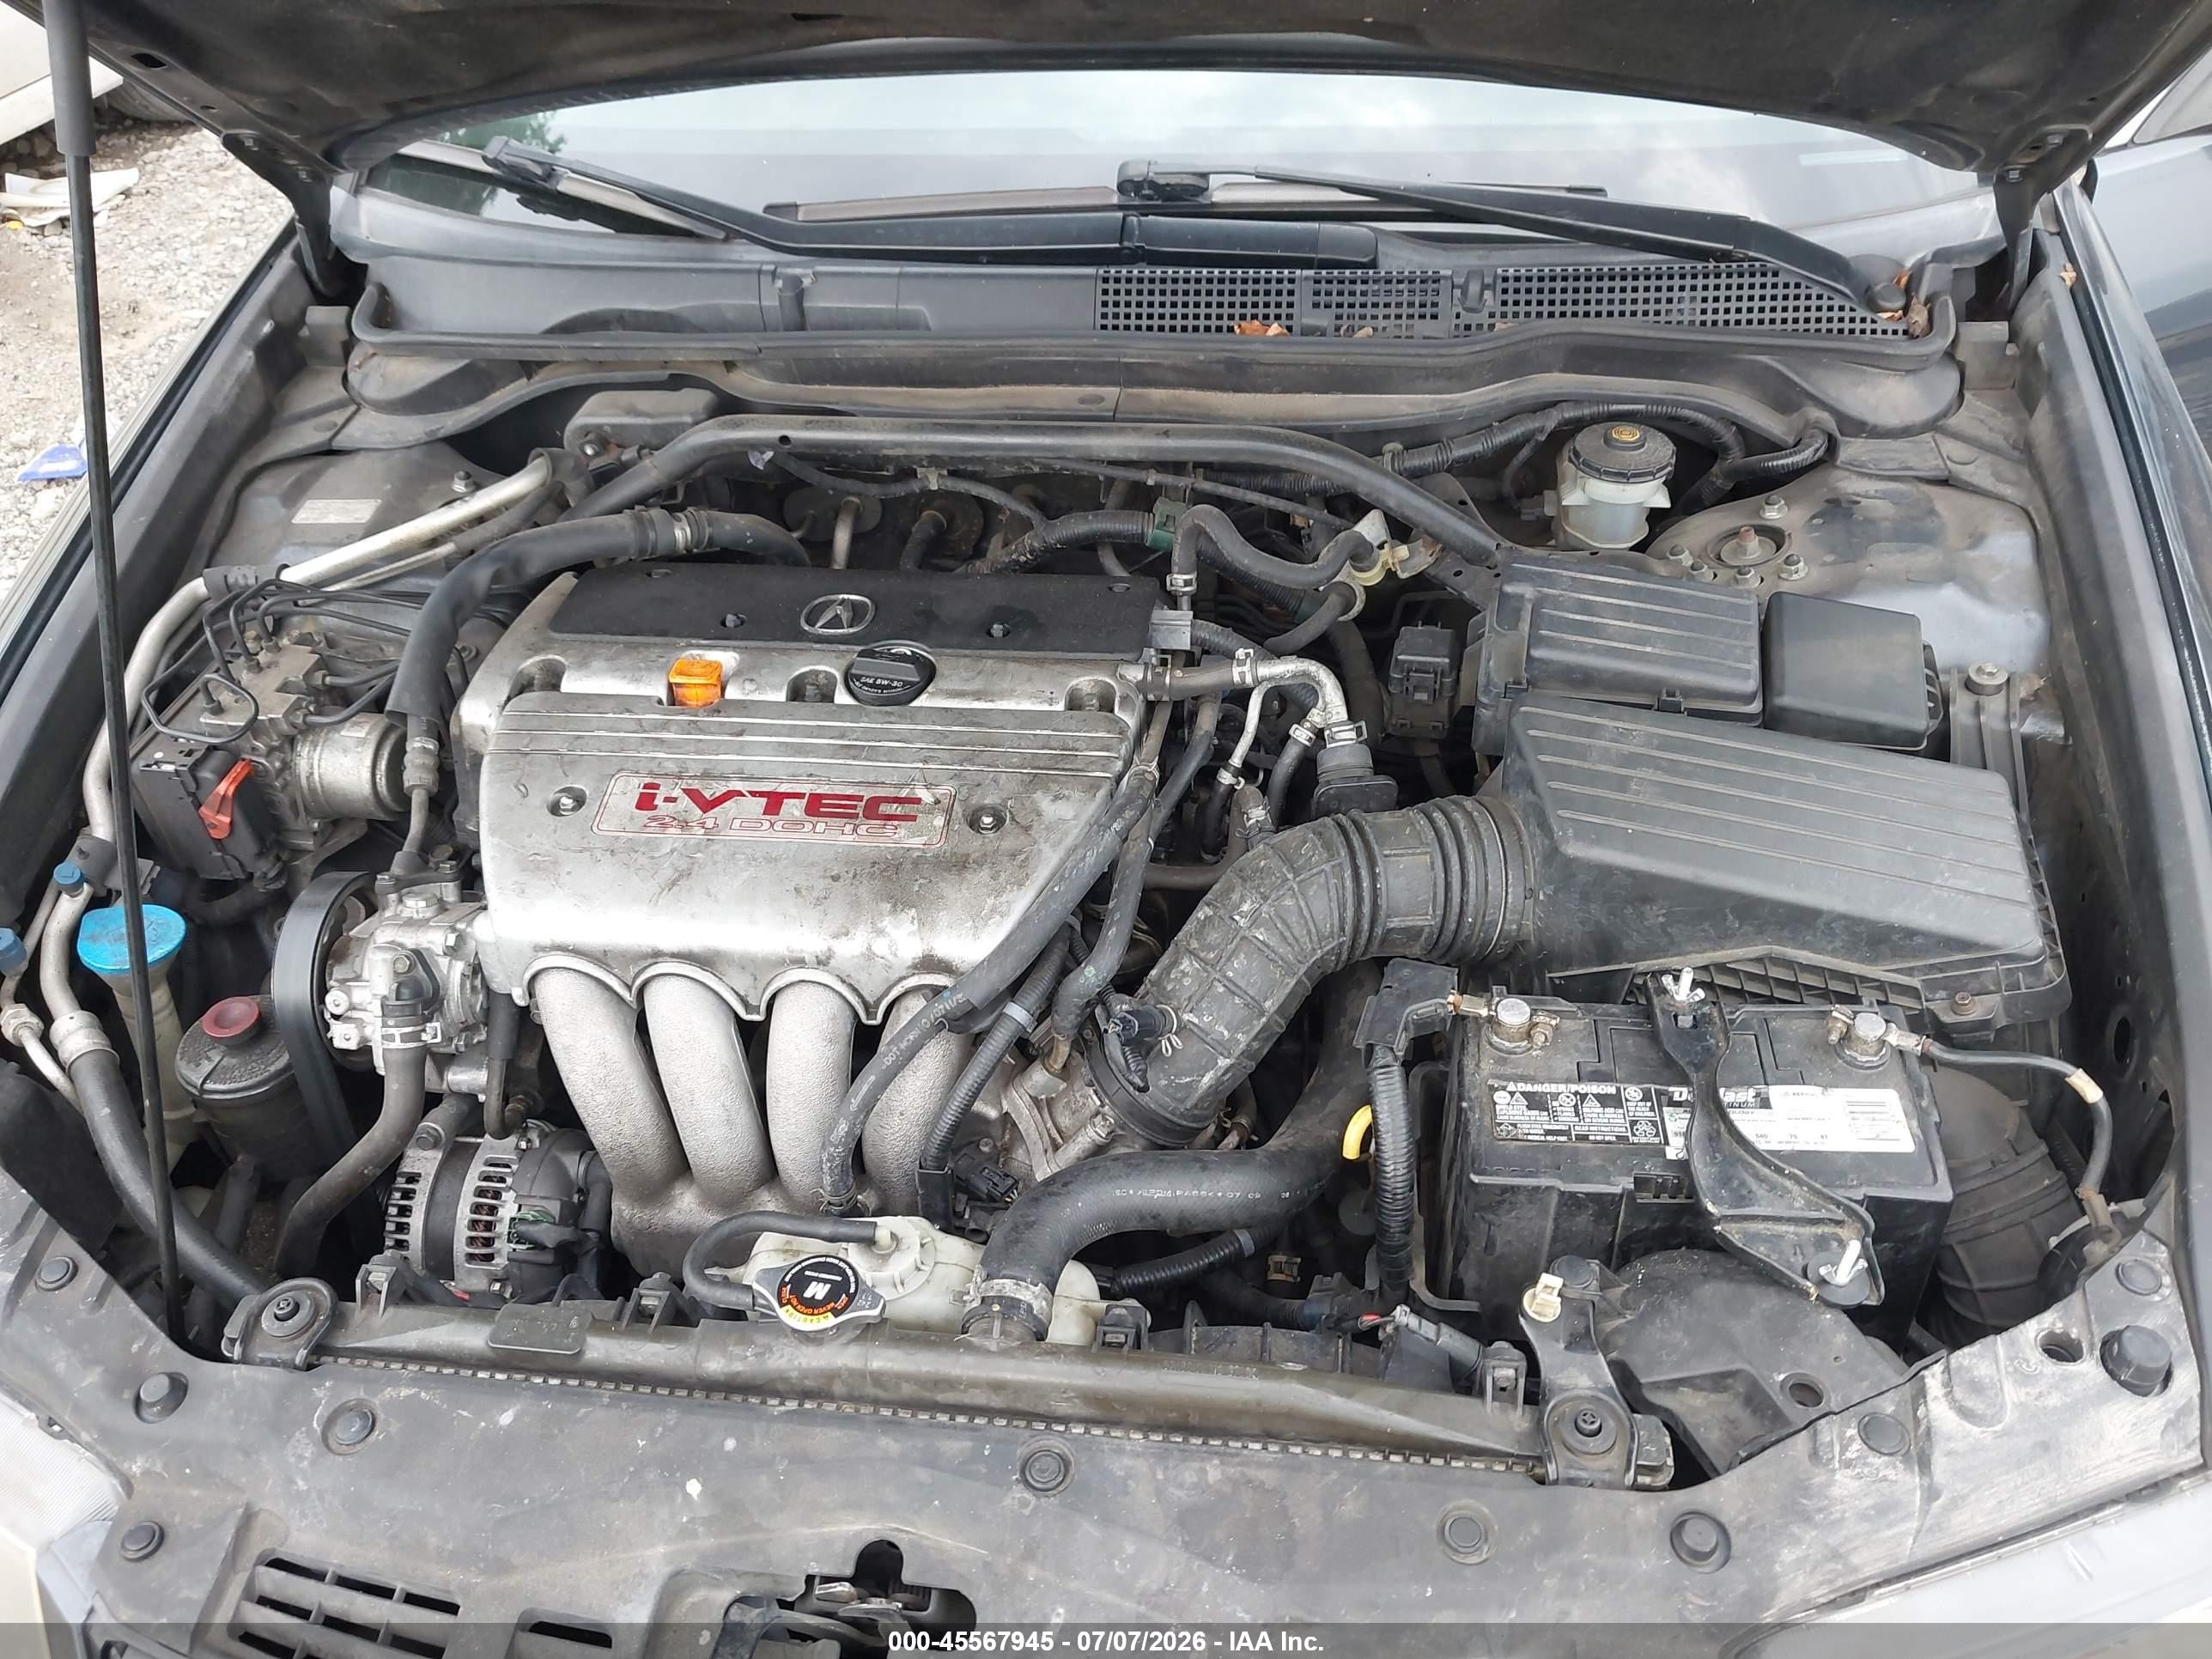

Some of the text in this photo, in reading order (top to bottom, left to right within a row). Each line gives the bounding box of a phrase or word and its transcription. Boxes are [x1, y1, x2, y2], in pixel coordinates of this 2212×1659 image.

[635, 782, 922, 822] i-VTEC
[644, 815, 898, 837] 2.4 DOHC
[1516, 1082, 1616, 1095] DANGER/POISON
[803, 1281, 831, 1300] M
[795, 1303, 813, 1315] OPEN
[813, 1301, 836, 1315] NEVER
